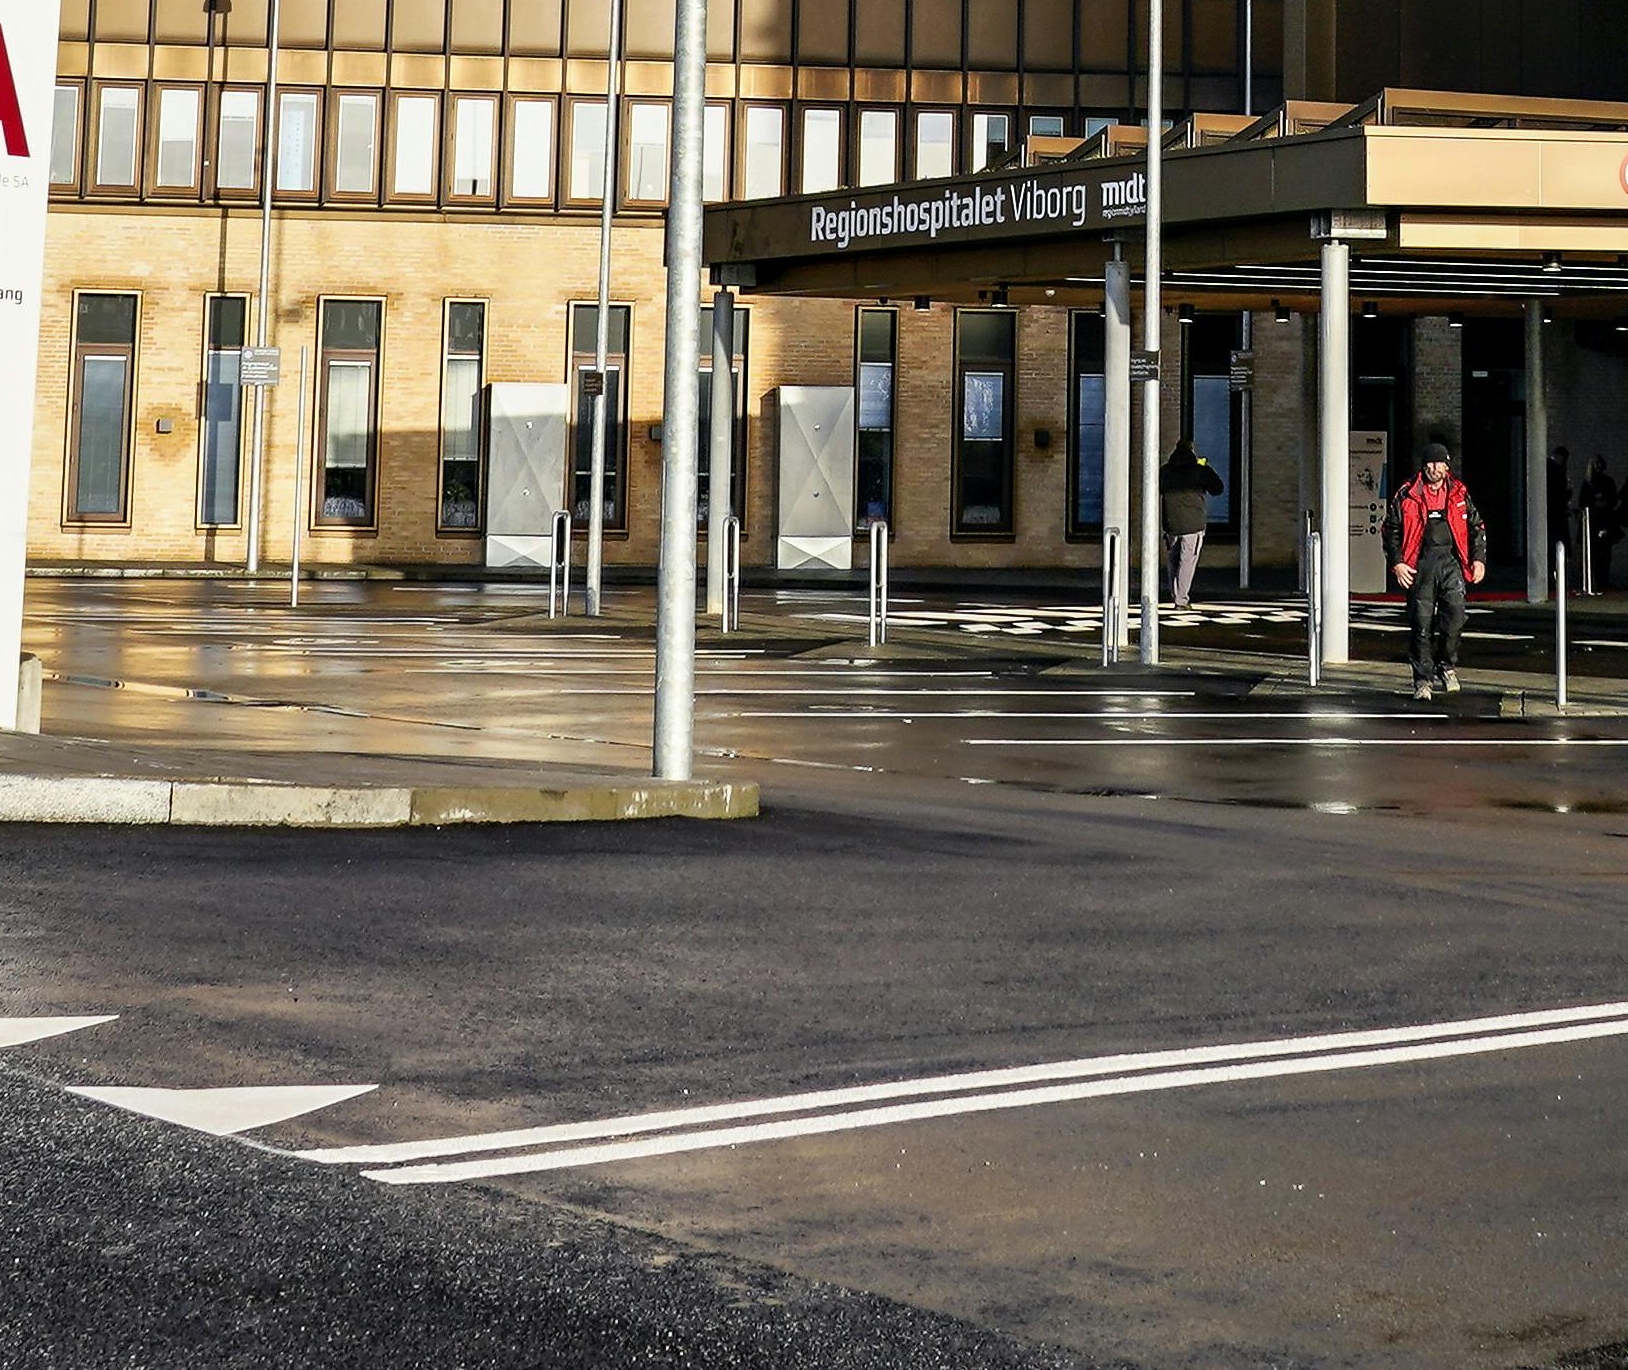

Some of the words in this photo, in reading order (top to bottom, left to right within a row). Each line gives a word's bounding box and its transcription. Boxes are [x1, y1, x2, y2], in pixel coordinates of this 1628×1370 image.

[810, 187, 1005, 248] Regionshospitalet
[1010, 179, 1087, 227] Viborg
[1100, 172, 1147, 207] midt
